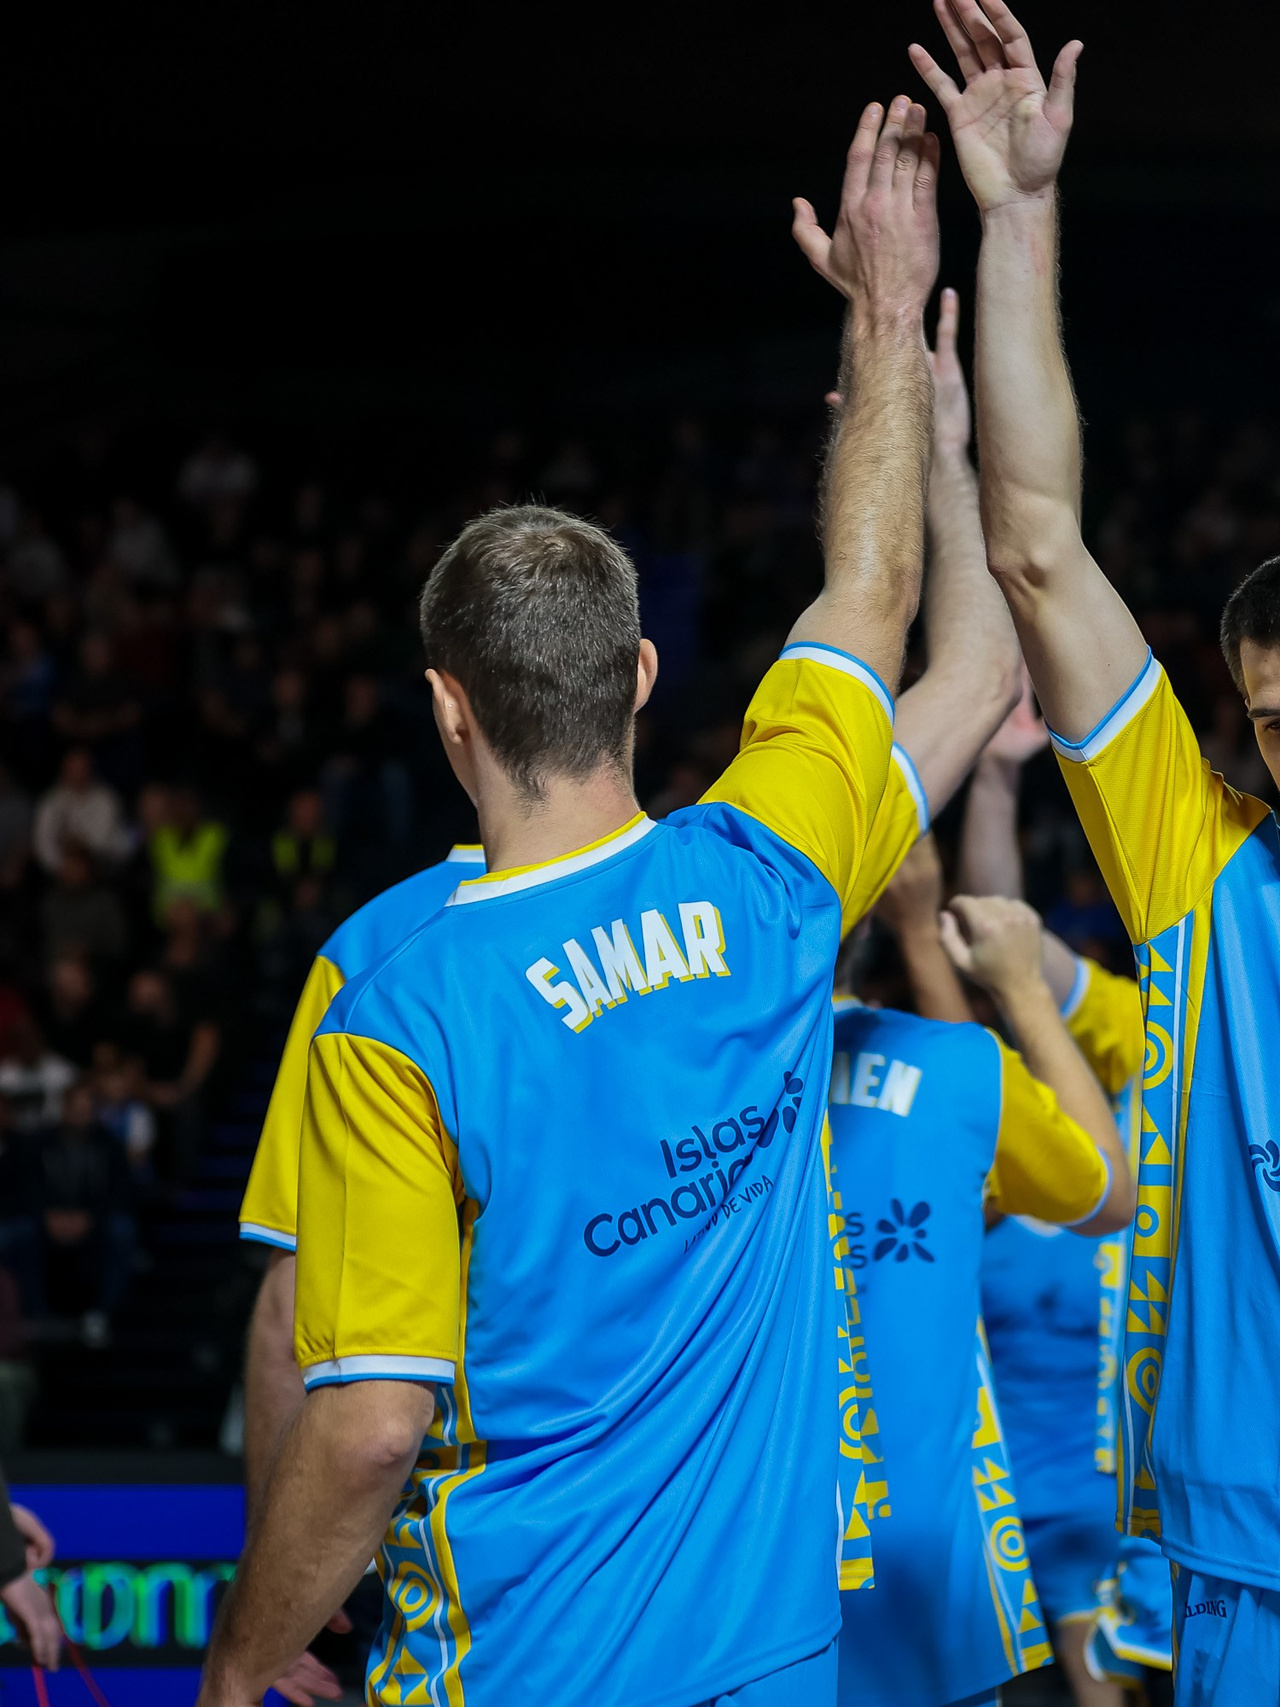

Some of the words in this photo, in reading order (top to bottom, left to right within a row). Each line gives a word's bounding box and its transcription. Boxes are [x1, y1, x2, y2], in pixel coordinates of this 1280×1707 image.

[525, 900, 731, 1034] SAMAR
[660, 1105, 766, 1179] Islas
[720, 1197, 742, 1220] DE
[738, 1174, 774, 1204] VIDA
